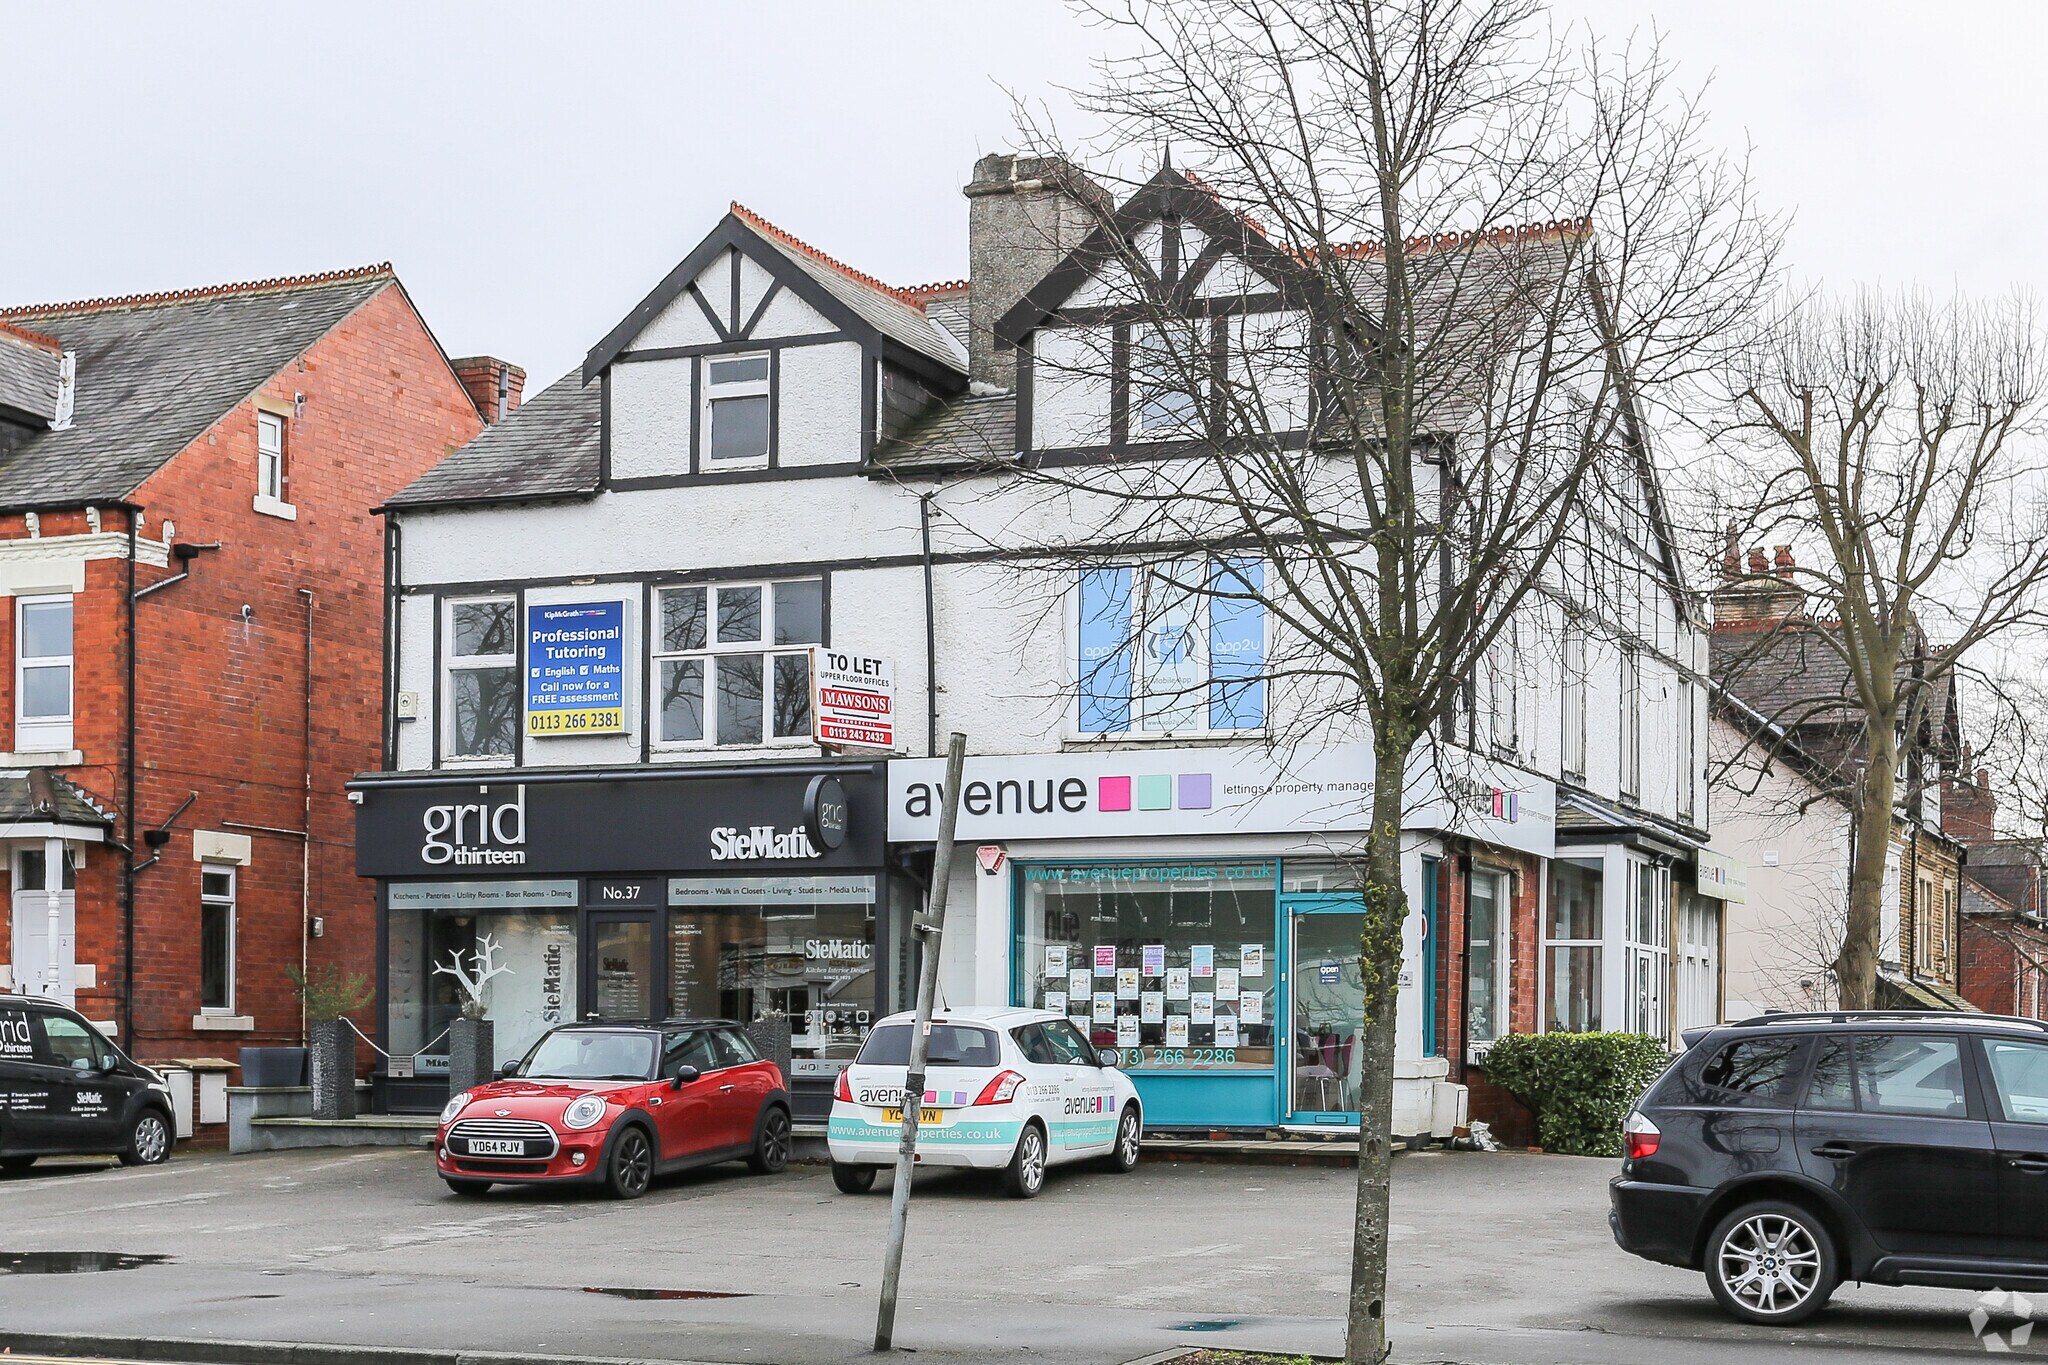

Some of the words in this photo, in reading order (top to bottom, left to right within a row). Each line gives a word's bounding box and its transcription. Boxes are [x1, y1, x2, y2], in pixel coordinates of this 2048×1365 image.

[532, 626, 619, 643] Professional
[545, 645, 606, 659] Tutoring
[1215, 639, 1260, 655] app2u
[545, 666, 576, 678] English
[593, 664, 620, 674] Maths
[827, 653, 848, 671] TO
[854, 657, 882, 676] LET
[540, 683, 560, 692] Call
[562, 683, 584, 691] now
[585, 681, 601, 690] for
[820, 671, 841, 680] UPPER
[842, 674, 863, 684] FLOOR
[863, 677, 890, 687] OFFICES
[532, 694, 557, 704] FREE
[560, 691, 619, 702] assessment
[824, 691, 886, 712] MAWSONS
[531, 714, 560, 730] 0113
[564, 713, 587, 728] 266
[590, 711, 620, 727] 2381
[828, 726, 848, 737] 0113
[848, 729, 865, 740] 243
[865, 731, 885, 743] 2432
[1223, 783, 1265, 796] lettings
[1275, 781, 1323, 795] property
[422, 784, 526, 864] grid
[453, 845, 526, 865] thirteen
[456, 891, 476, 900] Utility
[477, 891, 499, 899] Rooms
[522, 890, 545, 898] Rooms
[551, 889, 573, 899] Dining
[602, 886, 641, 900] No.37
[675, 888, 709, 896] Bedrooms
[741, 887, 766, 895] Closets
[772, 887, 793, 895] Living
[798, 886, 823, 894] Studies
[805, 939, 871, 959] SieMatic
[542, 944, 561, 1025] SieMatic
[3, 1042, 33, 1053] thirteen
[1153, 1048, 1185, 1066] 266
[1192, 1048, 1236, 1066] 2286
[1039, 1085, 1048, 1095] 266
[1064, 1096, 1096, 1115] avenue
[829, 1124, 1002, 1142] www.avenueoperties.co.uk
[472, 1141, 497, 1152] YD64
[500, 1142, 520, 1153] RJV
